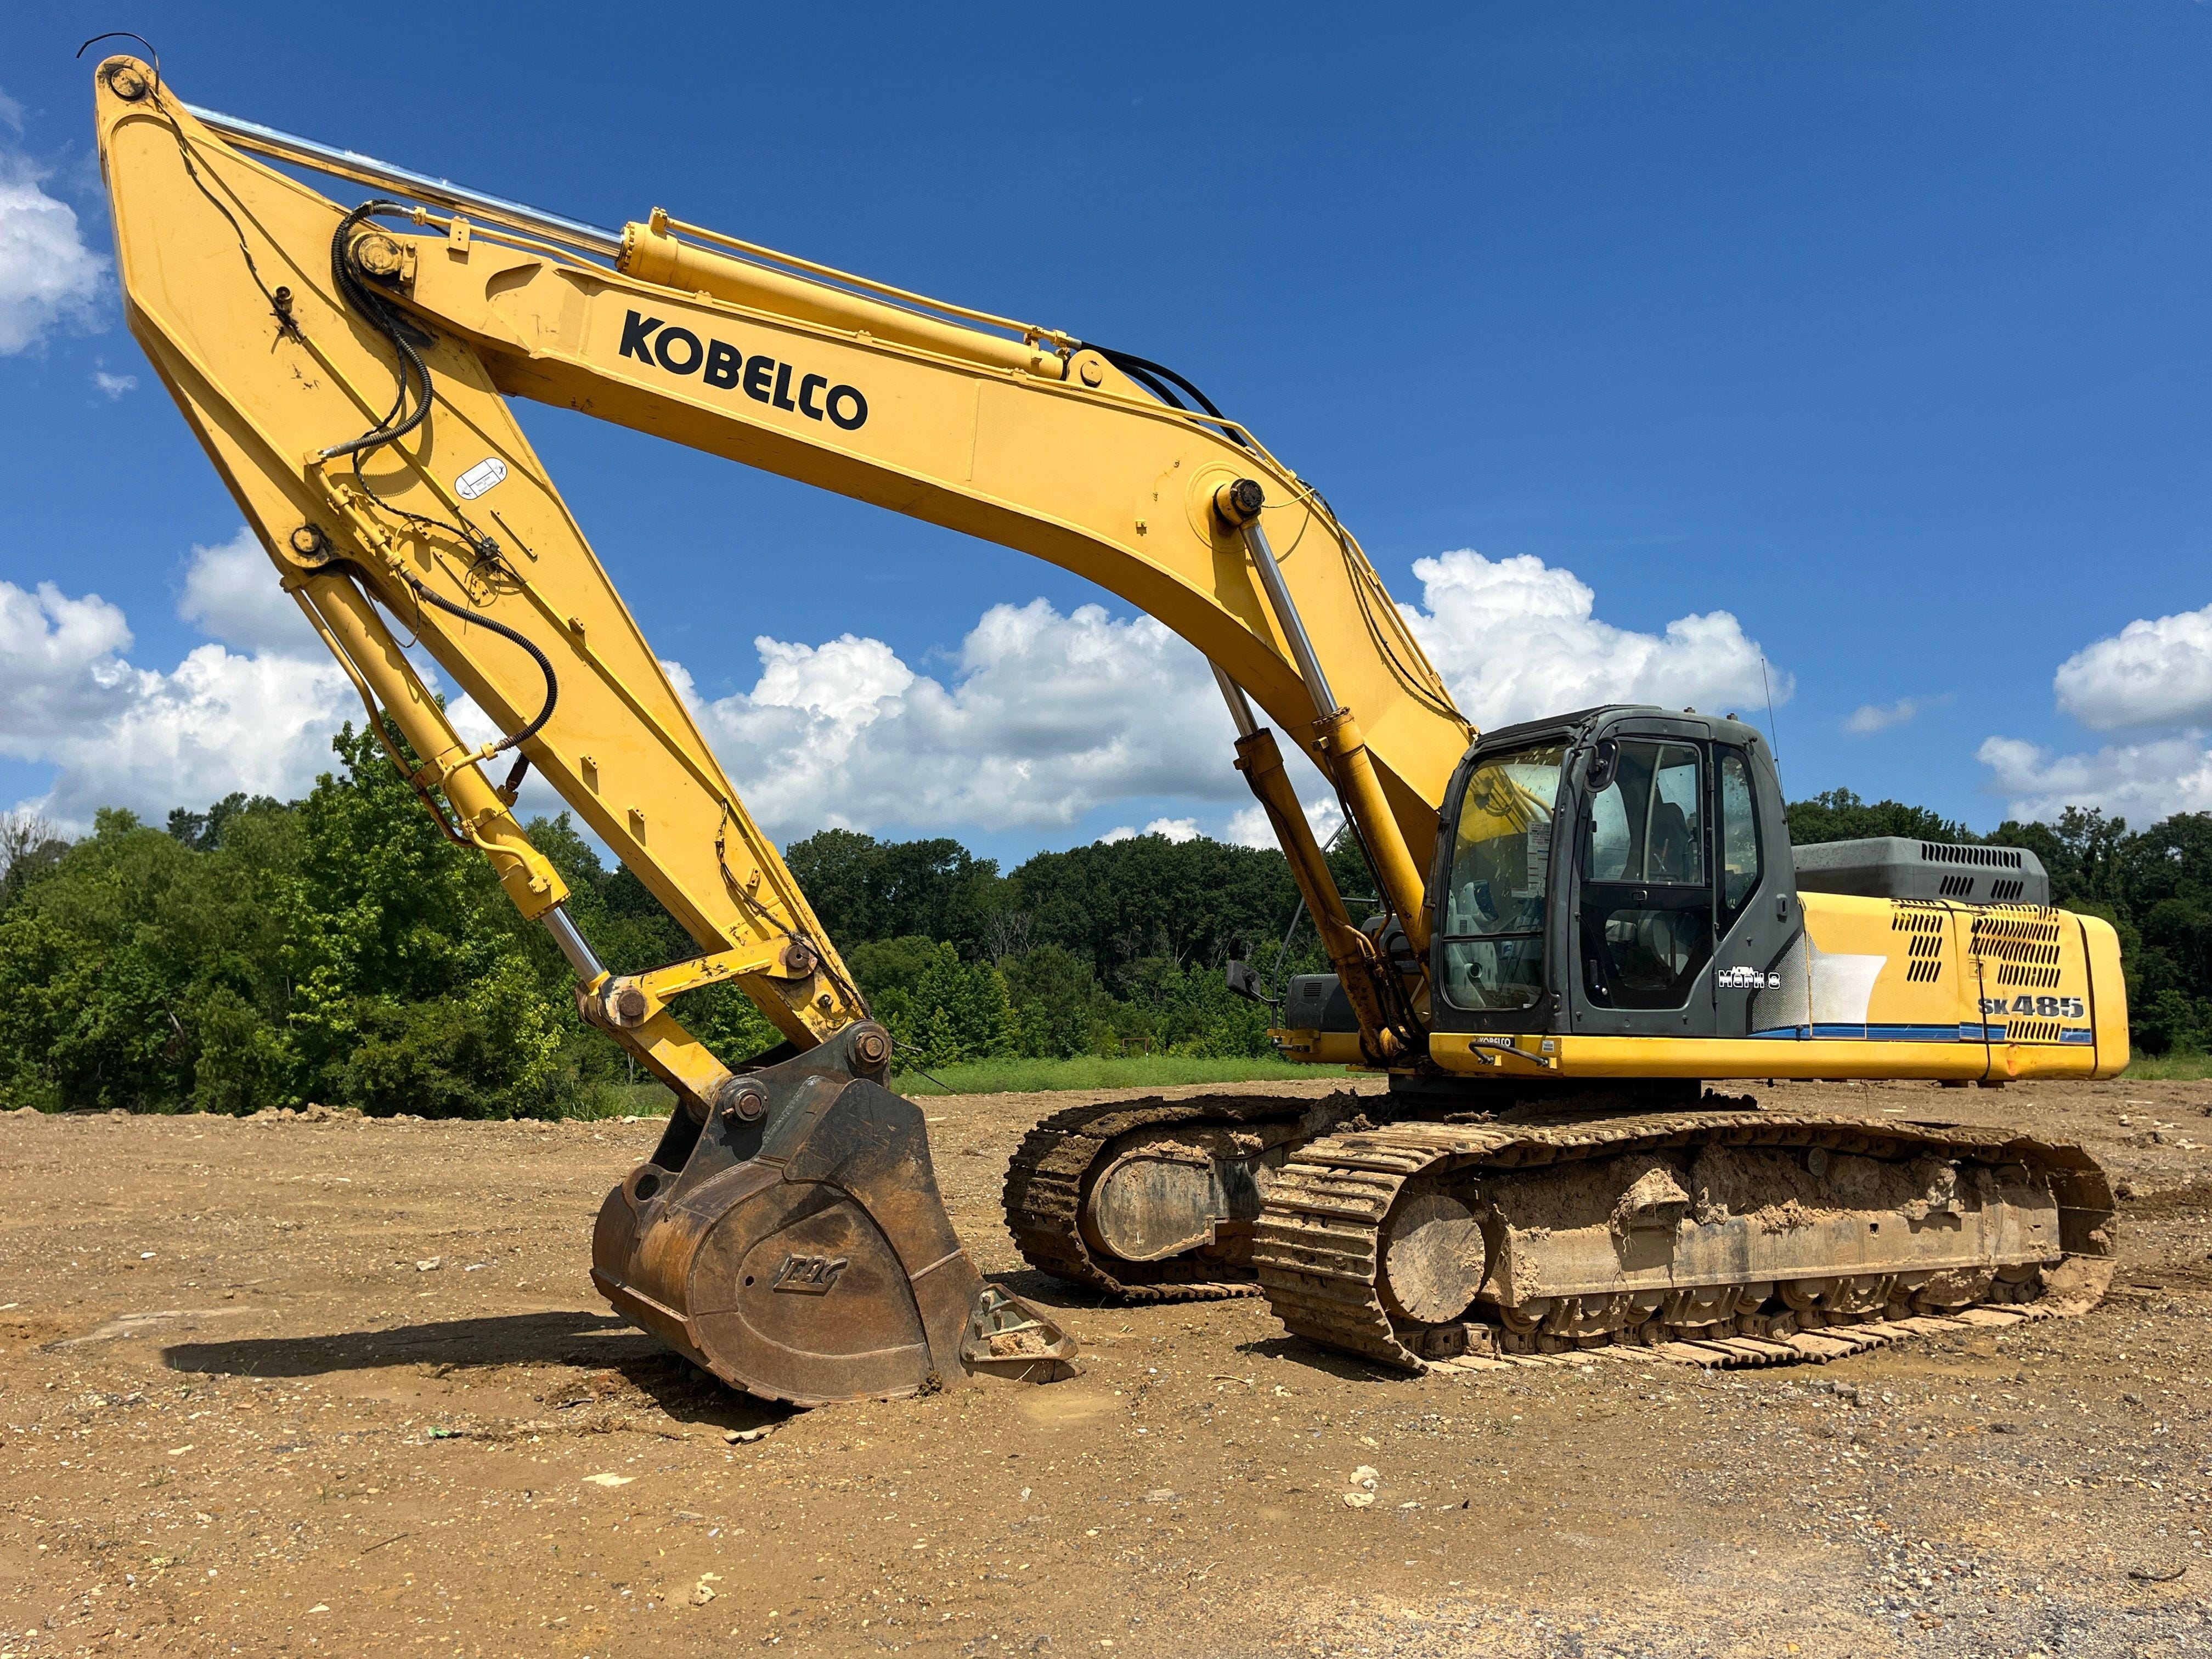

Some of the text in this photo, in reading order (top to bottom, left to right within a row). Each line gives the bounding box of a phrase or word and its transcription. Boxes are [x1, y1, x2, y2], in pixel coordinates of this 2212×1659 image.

[618, 309, 868, 431] KOBELCO
[1718, 969, 1781, 990] Mark 8
